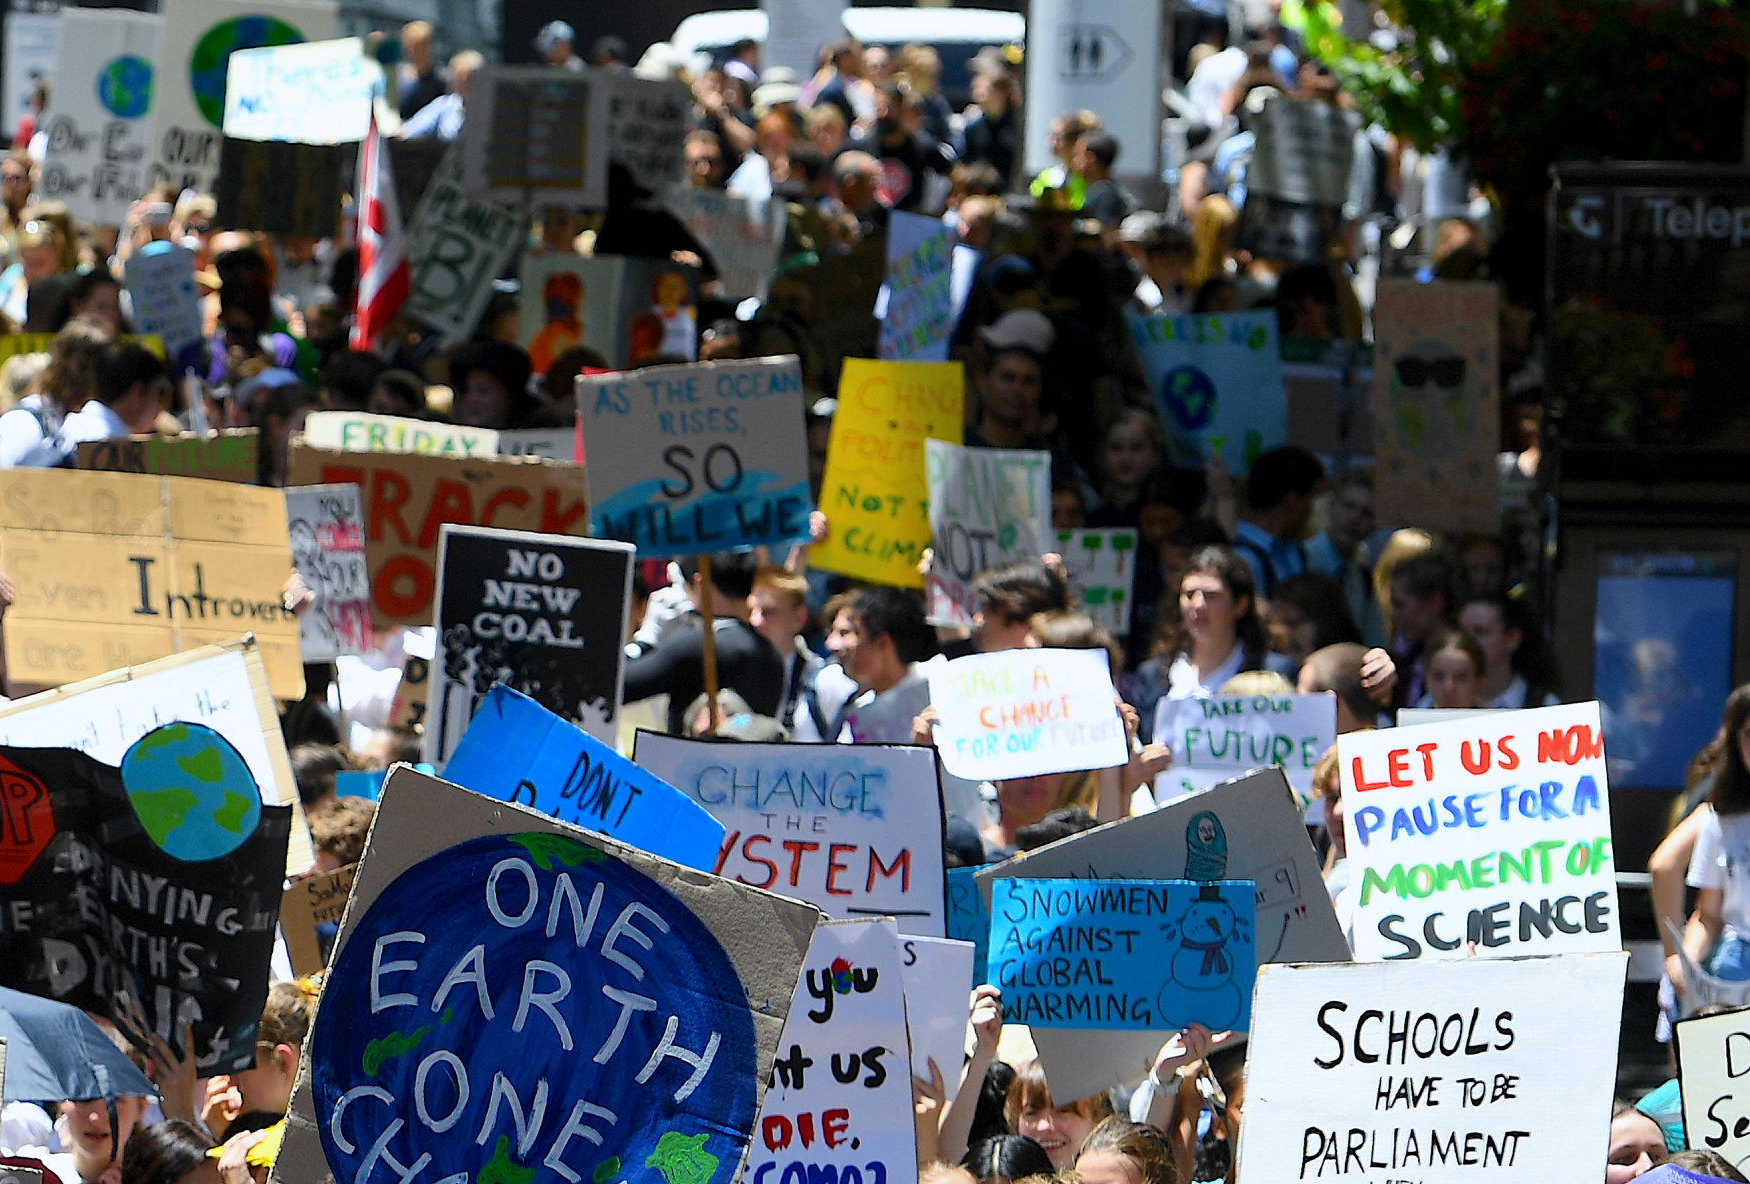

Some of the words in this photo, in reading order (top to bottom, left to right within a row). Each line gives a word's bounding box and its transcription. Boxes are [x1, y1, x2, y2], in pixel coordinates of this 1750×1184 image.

[594, 382, 632, 415] AS
[645, 375, 703, 402] THE
[715, 371, 801, 400] OCEAN
[342, 420, 479, 456] FRIDAY
[660, 442, 744, 500] SO
[602, 501, 721, 547] WILL
[736, 494, 803, 540] WE
[505, 548, 565, 581] NO
[483, 579, 582, 614] NEW
[473, 612, 585, 649] COAL
[980, 694, 1073, 730] CHANGE
[1201, 698, 1244, 718] TAKE
[1253, 695, 1293, 715] OUR
[956, 735, 998, 759] FOR
[1005, 729, 1044, 755] OUR
[1186, 726, 1319, 769] FUTURE
[1352, 742, 1438, 793] LET
[1461, 736, 1520, 776] US
[696, 765, 885, 816] CHANGE
[1354, 791, 1497, 848] PAUSE
[1499, 780, 1568, 822] FOR
[1571, 775, 1600, 816] A
[760, 813, 827, 834] THE
[1359, 840, 1568, 908] MOMENT
[1565, 836, 1611, 877] OF
[486, 856, 670, 984] ONE
[1003, 883, 1168, 924] SNOWMEN
[1377, 891, 1610, 960] SCIENCE
[1000, 927, 1141, 956] AGAINST
[1000, 958, 1114, 989] GLOBAL
[371, 931, 723, 1103] EARTH
[1000, 993, 1152, 1025] WARMING
[1314, 1000, 1516, 1071] SCHOOLS
[831, 1045, 889, 1089] us
[1374, 1075, 1443, 1112] HAVE
[1456, 1078, 1486, 1109] TO
[1490, 1073, 1521, 1101] BE
[414, 1049, 619, 1184] ONE
[761, 1108, 862, 1154] DIE.
[1299, 1126, 1532, 1180] PARLIAMENT
